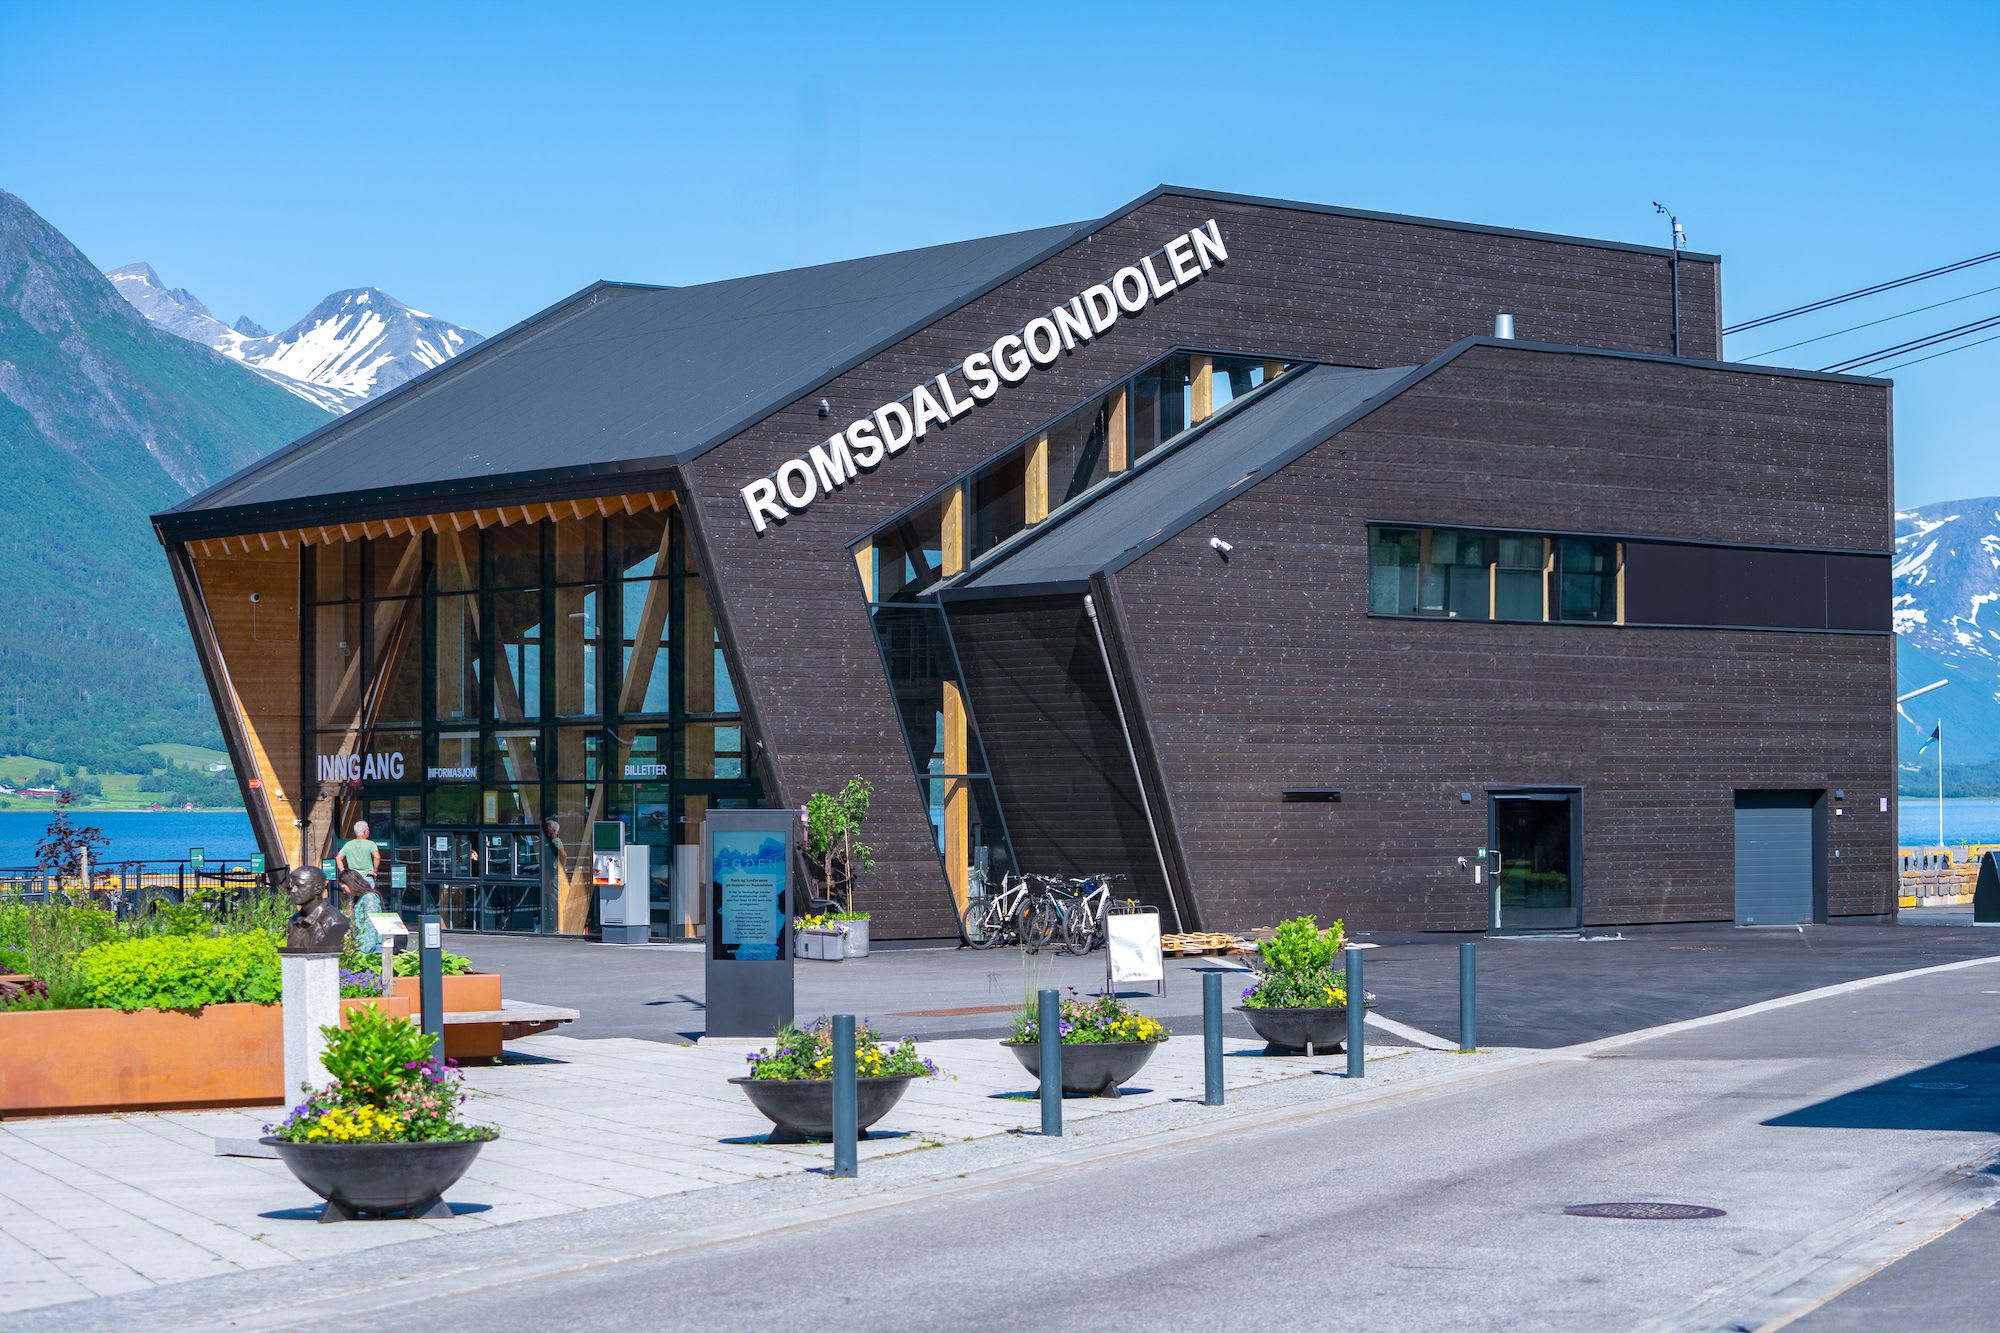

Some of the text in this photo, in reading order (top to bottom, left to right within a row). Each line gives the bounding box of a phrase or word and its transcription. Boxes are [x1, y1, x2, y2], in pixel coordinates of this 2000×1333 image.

[740, 218, 1229, 533] ROMSDALSGONDOLEN
[317, 752, 404, 781] INNGANG
[428, 767, 477, 778] INFORMASJON
[624, 764, 667, 776] BILLETTER
